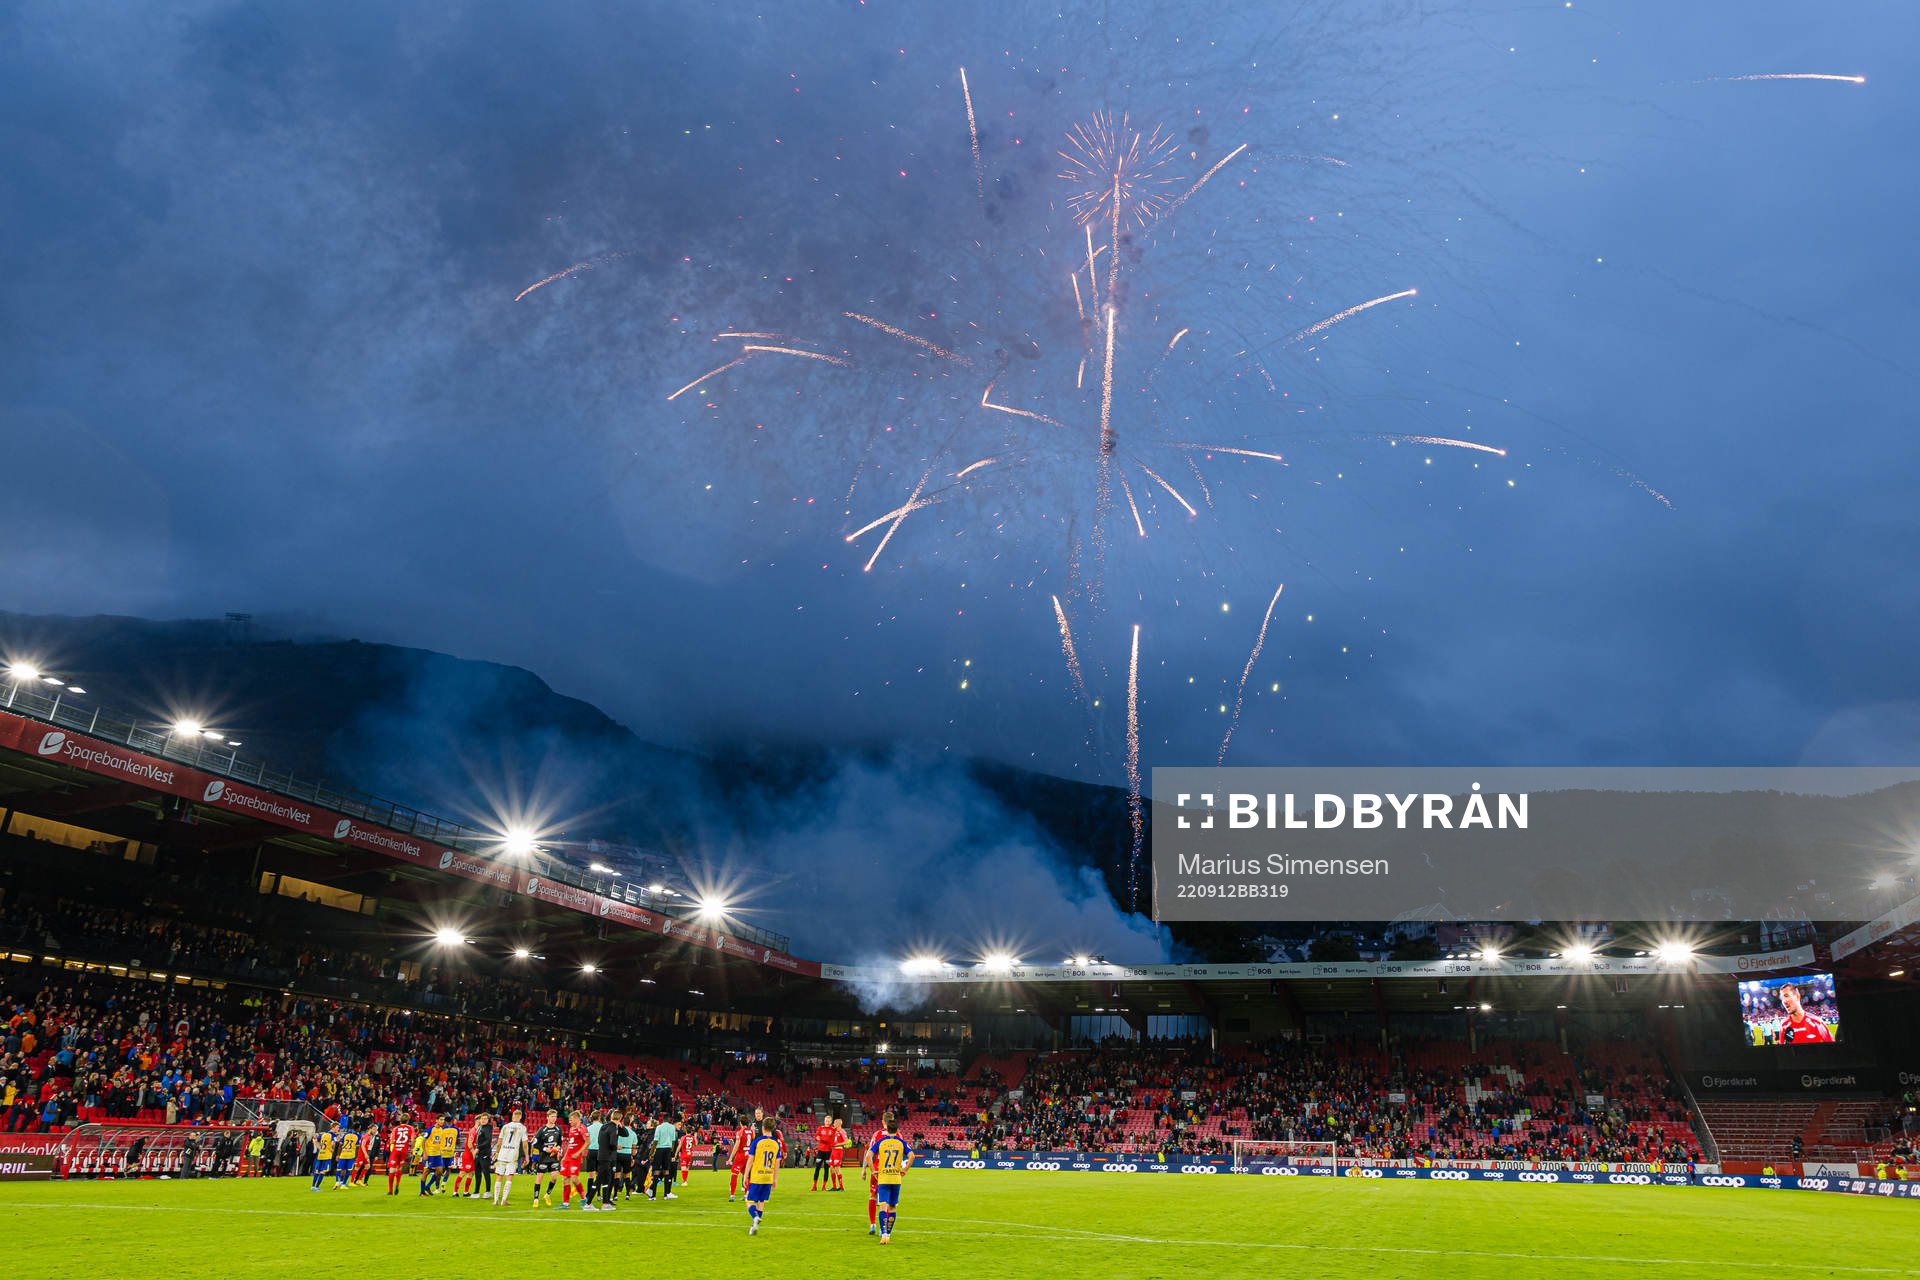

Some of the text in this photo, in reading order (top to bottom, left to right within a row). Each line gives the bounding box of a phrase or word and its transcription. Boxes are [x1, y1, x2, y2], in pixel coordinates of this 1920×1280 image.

[63, 740, 175, 785] SparebankenVest
[222, 788, 311, 825] SparebankenVest
[349, 825, 421, 857] SparebankenVest
[452, 857, 512, 884] SparebankenVest
[537, 883, 588, 906] SparebankenVest
[1750, 956, 1791, 969] Fjordkraft
[1714, 1077, 1757, 1087] Fjordkraft
[1812, 1076, 1856, 1087] Fjordkraft
[396, 1130, 409, 1144] 25
[763, 1150, 775, 1169] 18
[884, 1149, 900, 1169] 27
[924, 1159, 942, 1167] coop
[952, 1160, 986, 1170] coop
[1026, 1161, 1060, 1171] coop
[1102, 1163, 1138, 1173] coop
[1181, 1165, 1218, 1175] coop
[1496, 1161, 1525, 1171] 07000
[1261, 1166, 1299, 1176] coop
[1396, 1169, 1417, 1177] coop
[1430, 1170, 1470, 1180] coop
[1483, 1171, 1505, 1179] coop
[1518, 1172, 1560, 1183] coop
[1573, 1173, 1595, 1181] coop
[1609, 1174, 1651, 1186] coop
[1702, 1176, 1746, 1188] coop
[1759, 1177, 1782, 1185] coop
